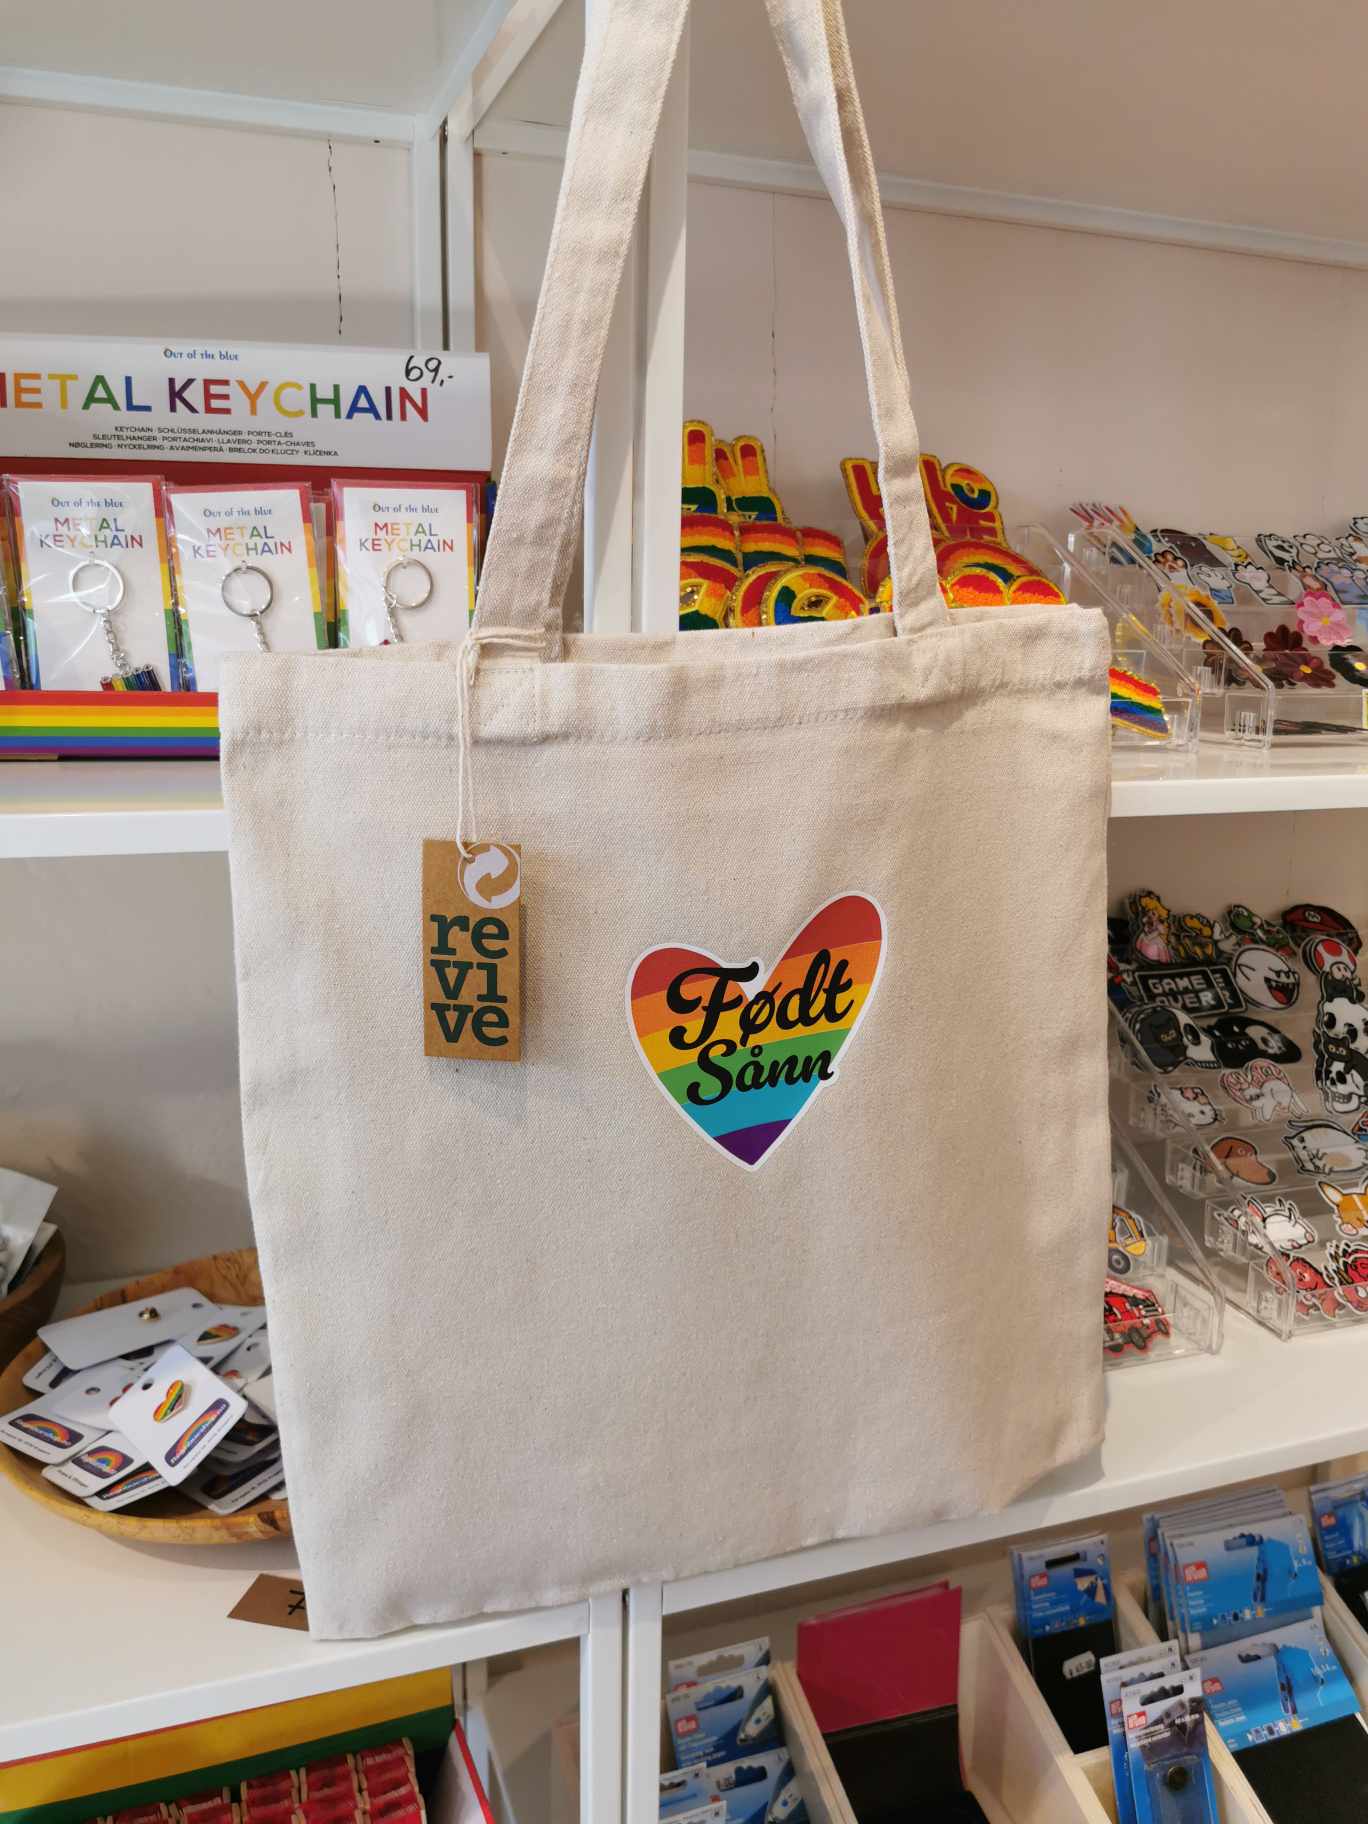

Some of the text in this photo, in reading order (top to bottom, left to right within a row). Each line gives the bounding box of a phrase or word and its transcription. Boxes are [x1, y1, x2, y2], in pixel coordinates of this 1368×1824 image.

[163, 348, 239, 361] Out of the blue
[168, 377, 429, 423] KEYCHAIN
[207, 525, 274, 541] METAL
[374, 521, 439, 536] METAL
[40, 534, 144, 549] KEYCHAIN
[192, 540, 292, 559] KEYCHAIN
[359, 538, 454, 552] KEYCHAIN
[429, 913, 510, 960] re
[1148, 975, 1207, 994] GAME
[666, 949, 855, 1051] Født
[430, 1002, 509, 1047] ve
[686, 1038, 835, 1107] Sånn
